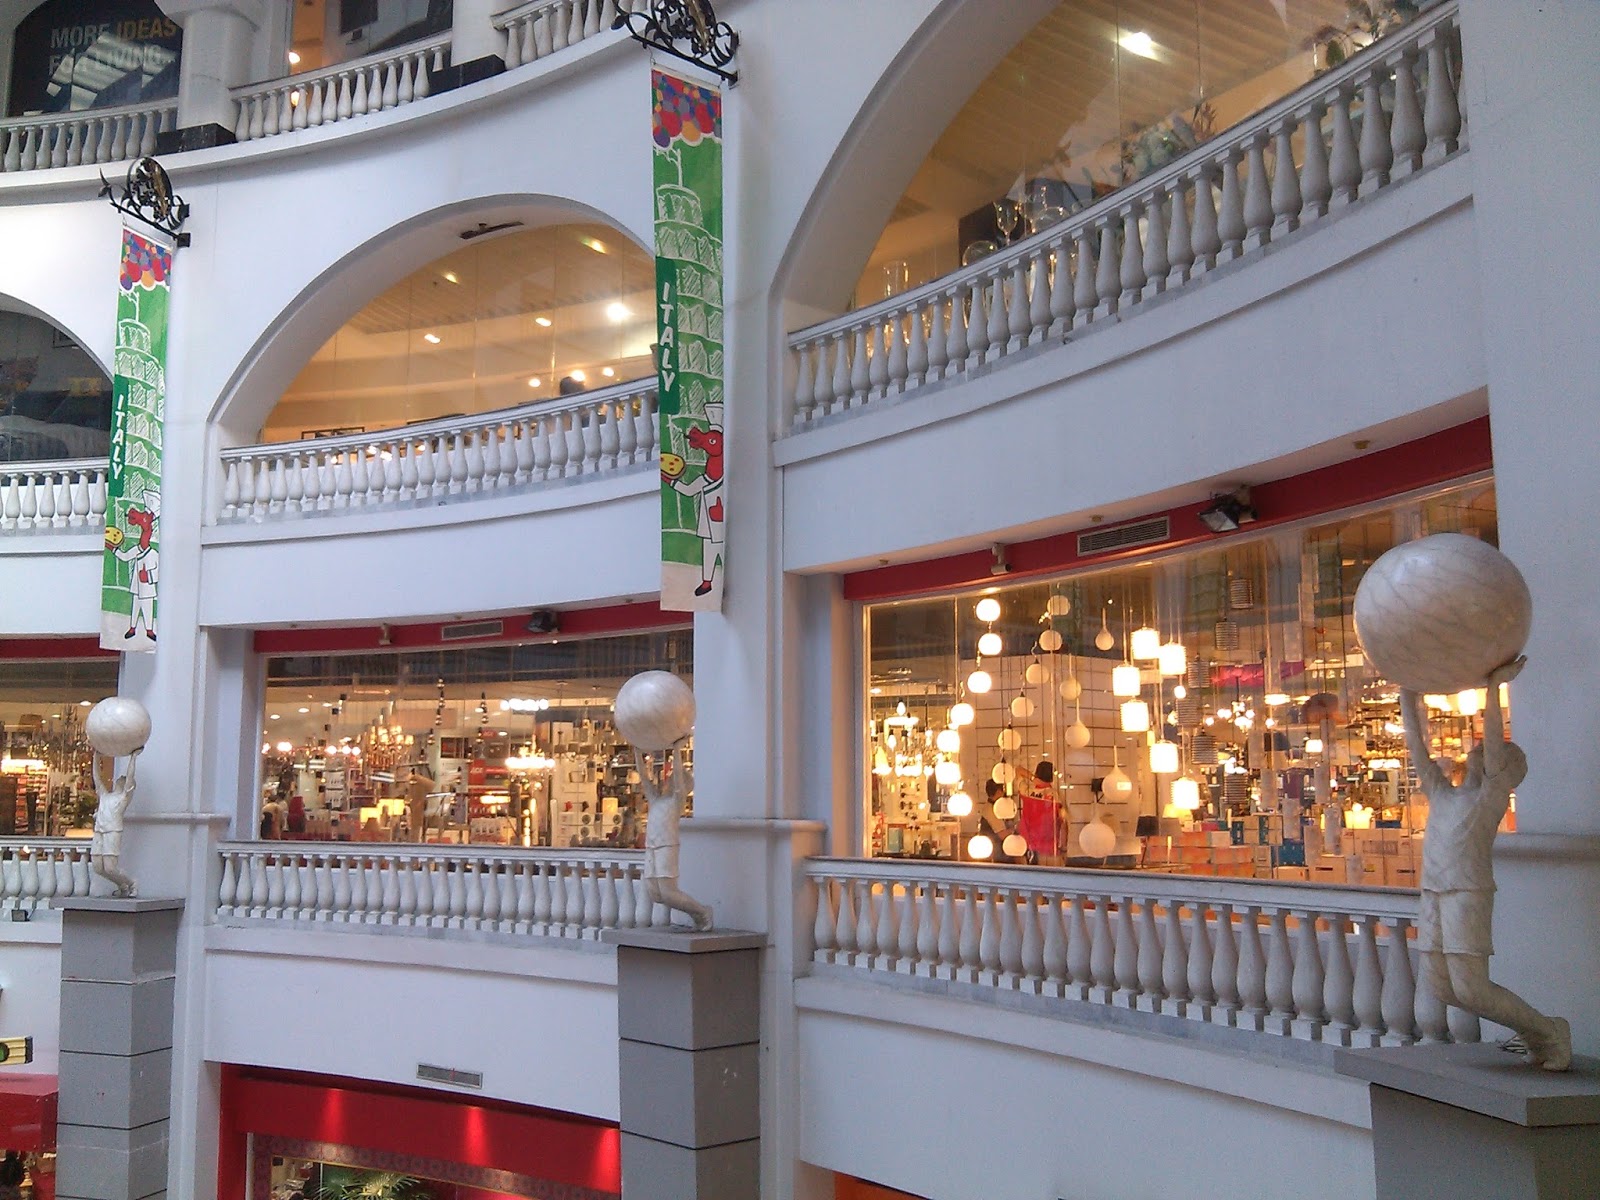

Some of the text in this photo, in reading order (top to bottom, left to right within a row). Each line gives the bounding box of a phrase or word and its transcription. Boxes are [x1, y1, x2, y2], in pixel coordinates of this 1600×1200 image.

[50, 18, 176, 49] MORE IDEAS
[660, 281, 676, 392] ITALY
[112, 394, 125, 480] ITALY
